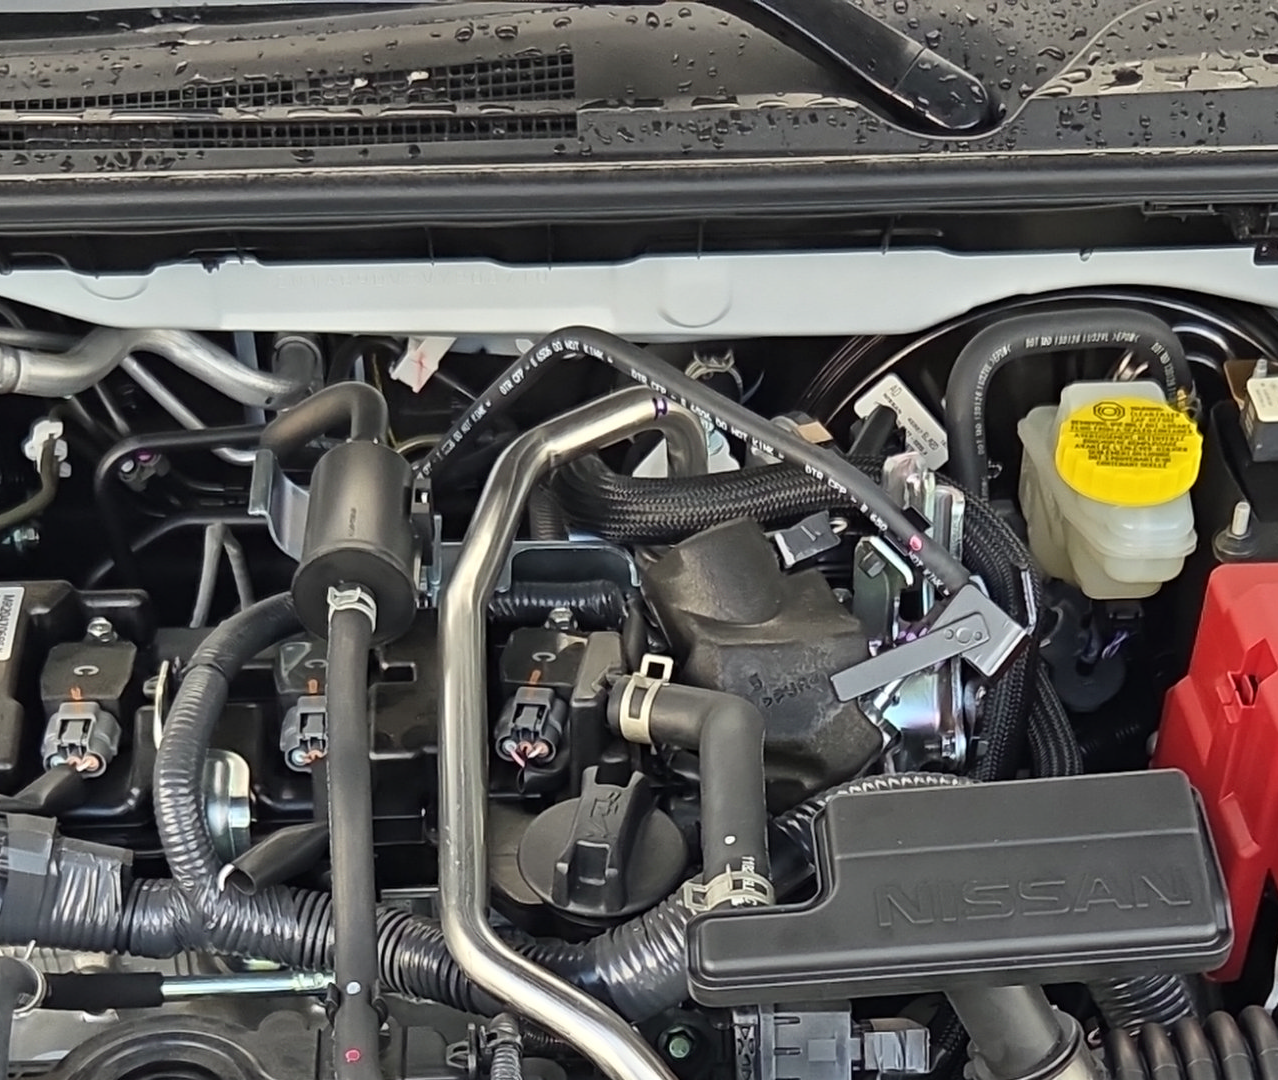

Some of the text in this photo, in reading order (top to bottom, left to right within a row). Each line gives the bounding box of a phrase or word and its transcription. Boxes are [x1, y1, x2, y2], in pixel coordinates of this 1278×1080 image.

[564, 338, 580, 351] NOT
[715, 417, 728, 432] DO
[730, 425, 749, 442] NOT
[751, 434, 775, 456] KINK
[804, 463, 824, 481] DTR
[827, 476, 848, 494] CFP
[876, 873, 1192, 927] NISSAN
